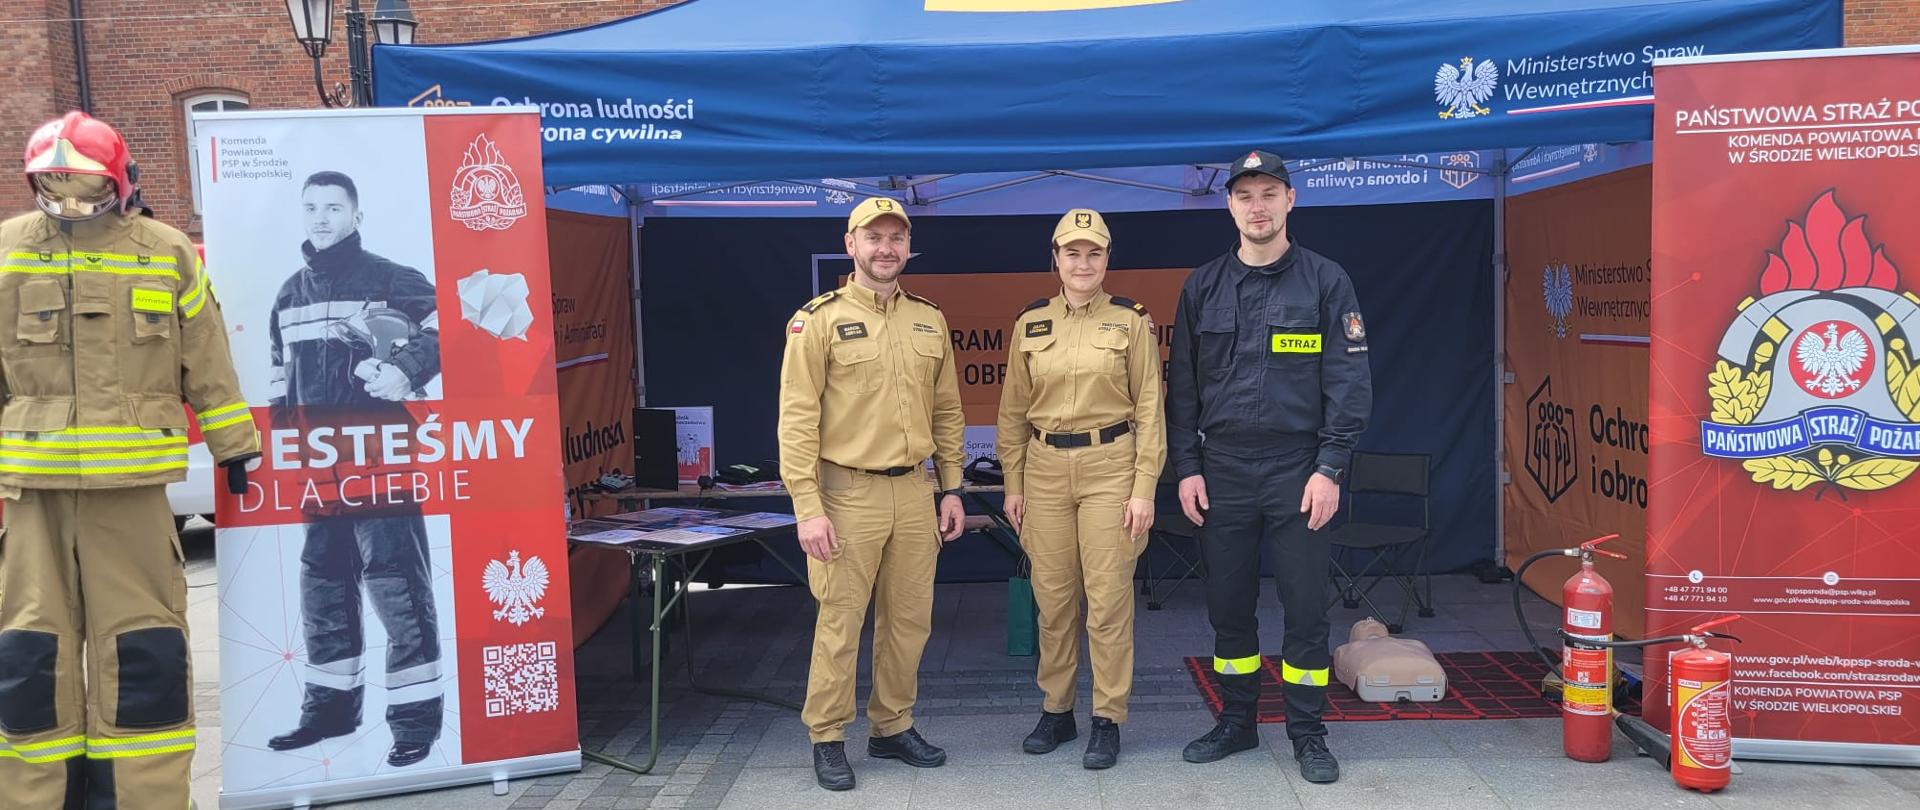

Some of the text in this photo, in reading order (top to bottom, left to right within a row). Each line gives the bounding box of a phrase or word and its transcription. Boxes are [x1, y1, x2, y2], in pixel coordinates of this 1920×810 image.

[1506, 51, 1636, 77] Ministerstwo
[1503, 71, 1654, 101] Wewnętrznych
[597, 98, 694, 120] ludności
[1675, 104, 1819, 128] PAŃSTWOWA
[1823, 97, 1891, 121] STRAŻ
[220, 136, 267, 145] Komenda
[591, 124, 683, 144] cywilna
[1728, 132, 1804, 148] KOMENDA
[1808, 128, 1913, 145] POWIATOWA
[221, 148, 273, 157] Powiatowa
[221, 159, 240, 168] PSP
[252, 157, 289, 167] Środzie
[1728, 151, 1745, 164] W
[1749, 147, 1813, 163] ŚRODZIE
[221, 169, 293, 180] Wielkopolskiej
[1575, 260, 1644, 286] Ministerstwo
[1706, 423, 1804, 453] PAŃSTWOWA
[1808, 414, 1858, 438] STRAŻ
[966, 440, 994, 450] Spraw
[1591, 454, 1597, 494] i
[239, 469, 472, 513] DLA CIEBIE
[1734, 686, 1793, 698] KOMENDA
[1795, 687, 1876, 700] POWIATOWA
[1878, 691, 1903, 701] PSP
[1734, 699, 1902, 716] W ŚRODZIE WIELKOPOLSKIEJ
